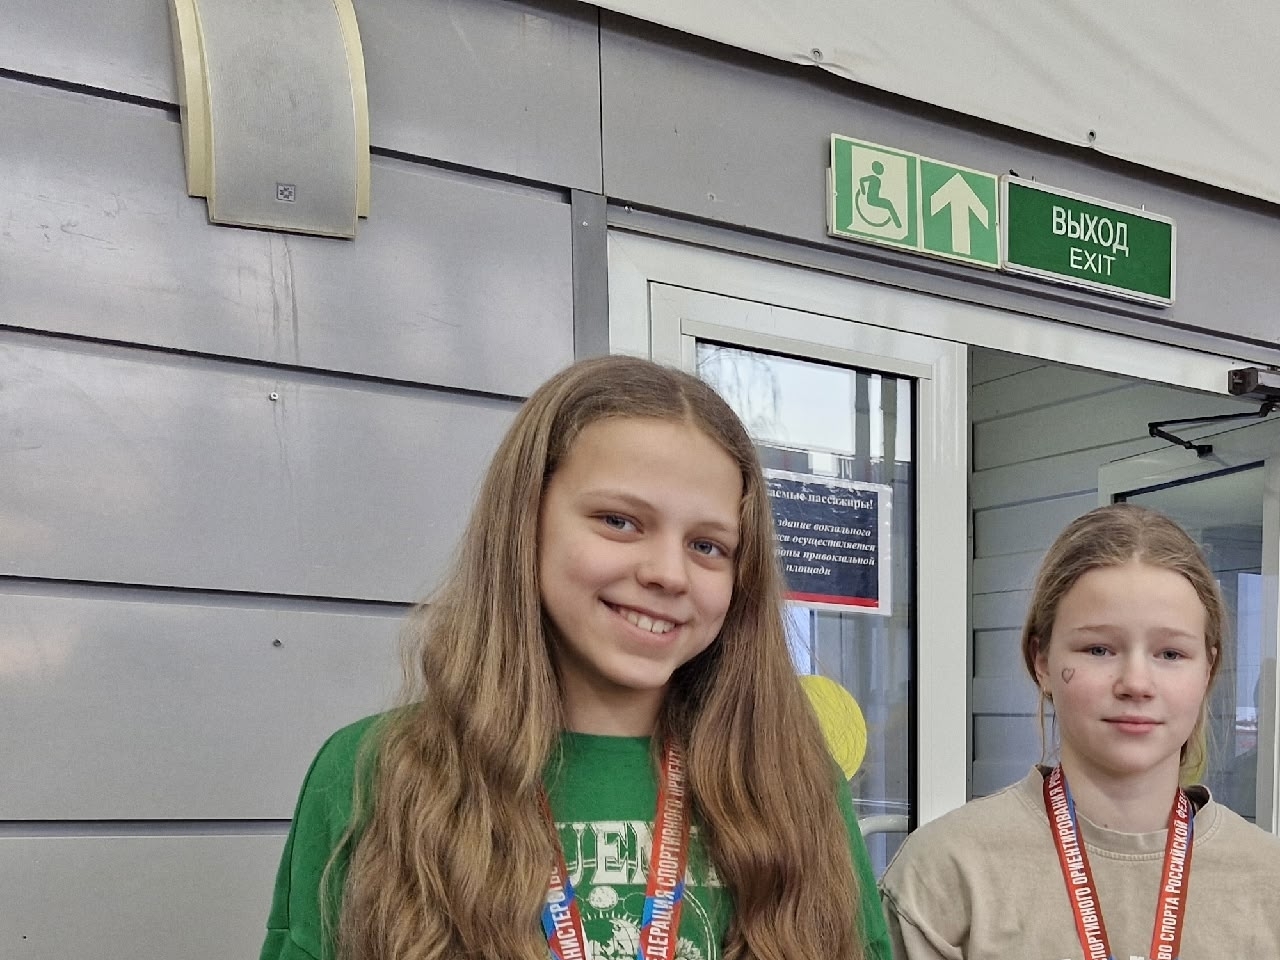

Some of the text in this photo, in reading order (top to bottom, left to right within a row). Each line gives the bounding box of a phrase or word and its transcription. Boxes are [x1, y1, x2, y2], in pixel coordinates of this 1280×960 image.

[1052, 206, 1129, 257] ВЫХОД
[1070, 248, 1116, 276] EXIT
[808, 493, 873, 510] пассажиры!
[777, 518, 871, 537] здание вокзального
[792, 534, 876, 552] осуществляется
[786, 563, 831, 576] площади
[802, 551, 875, 566] привокзальной
[655, 799, 683, 883] СПОРТИВНОГО
[1050, 786, 1088, 885] ОРИЕНТИРОВАНИЯ
[1165, 820, 1188, 893] РОССИЙСКОЙ
[1160, 897, 1180, 943] СПОРТА
